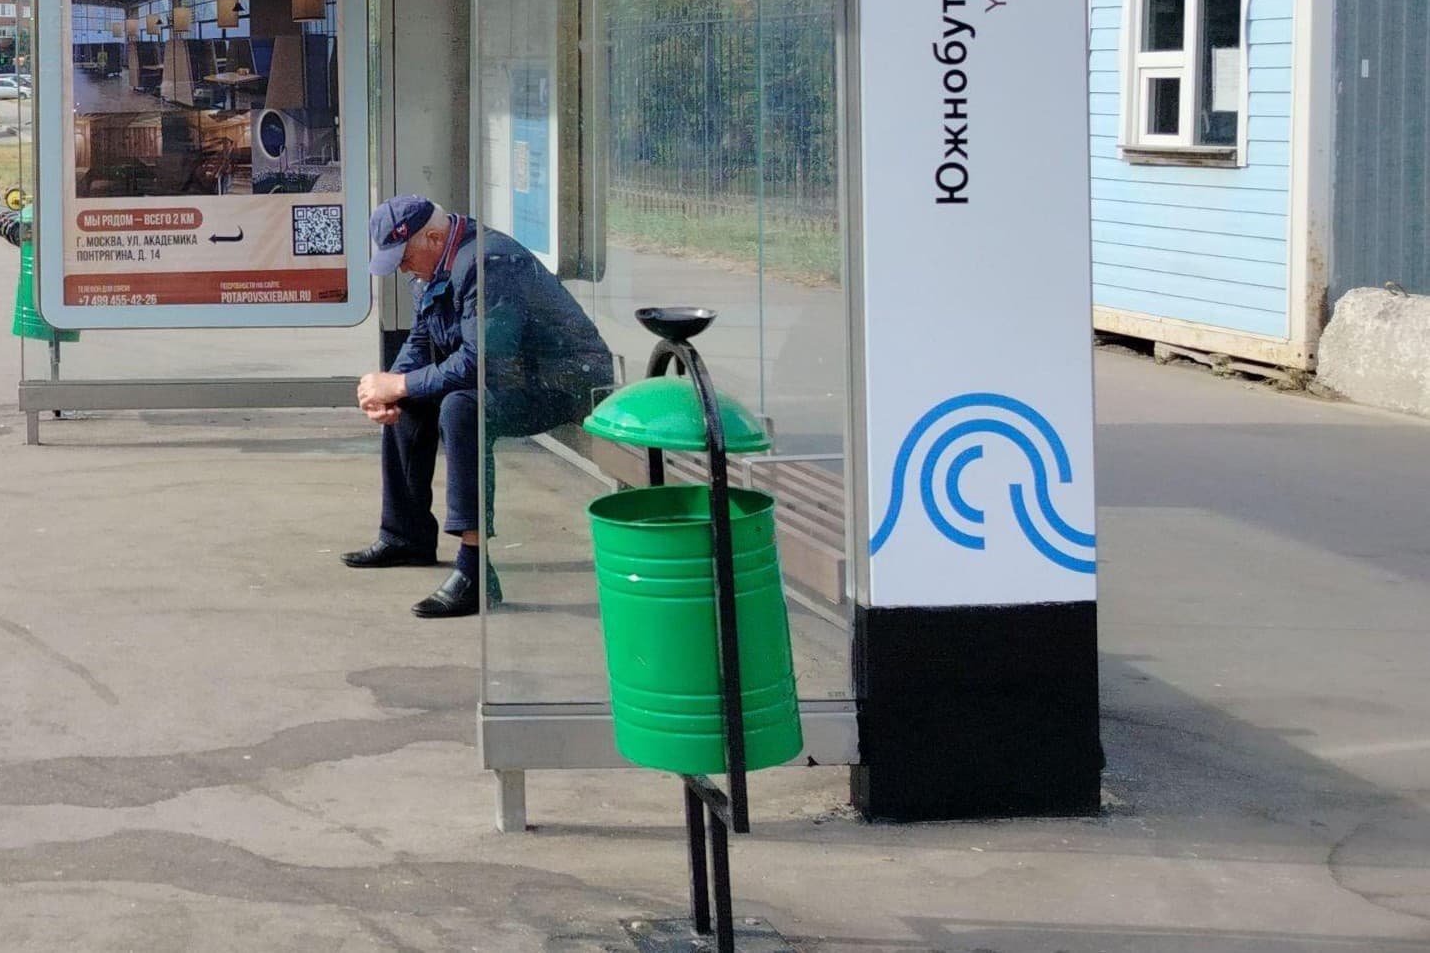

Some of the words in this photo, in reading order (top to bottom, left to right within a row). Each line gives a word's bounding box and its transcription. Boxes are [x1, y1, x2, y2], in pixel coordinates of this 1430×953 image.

[84, 215, 100, 226] МЫ
[102, 215, 133, 226] РЯДОМ
[144, 213, 172, 225] ВСЕГО
[173, 214, 179, 225] 2
[180, 213, 195, 224] КМ
[127, 236, 140, 247] УЛ.
[143, 234, 198, 246] АКАДЕМИКА
[151, 249, 161, 260] 14
[221, 290, 312, 303] POTAPOVSKIEBANI.RU
